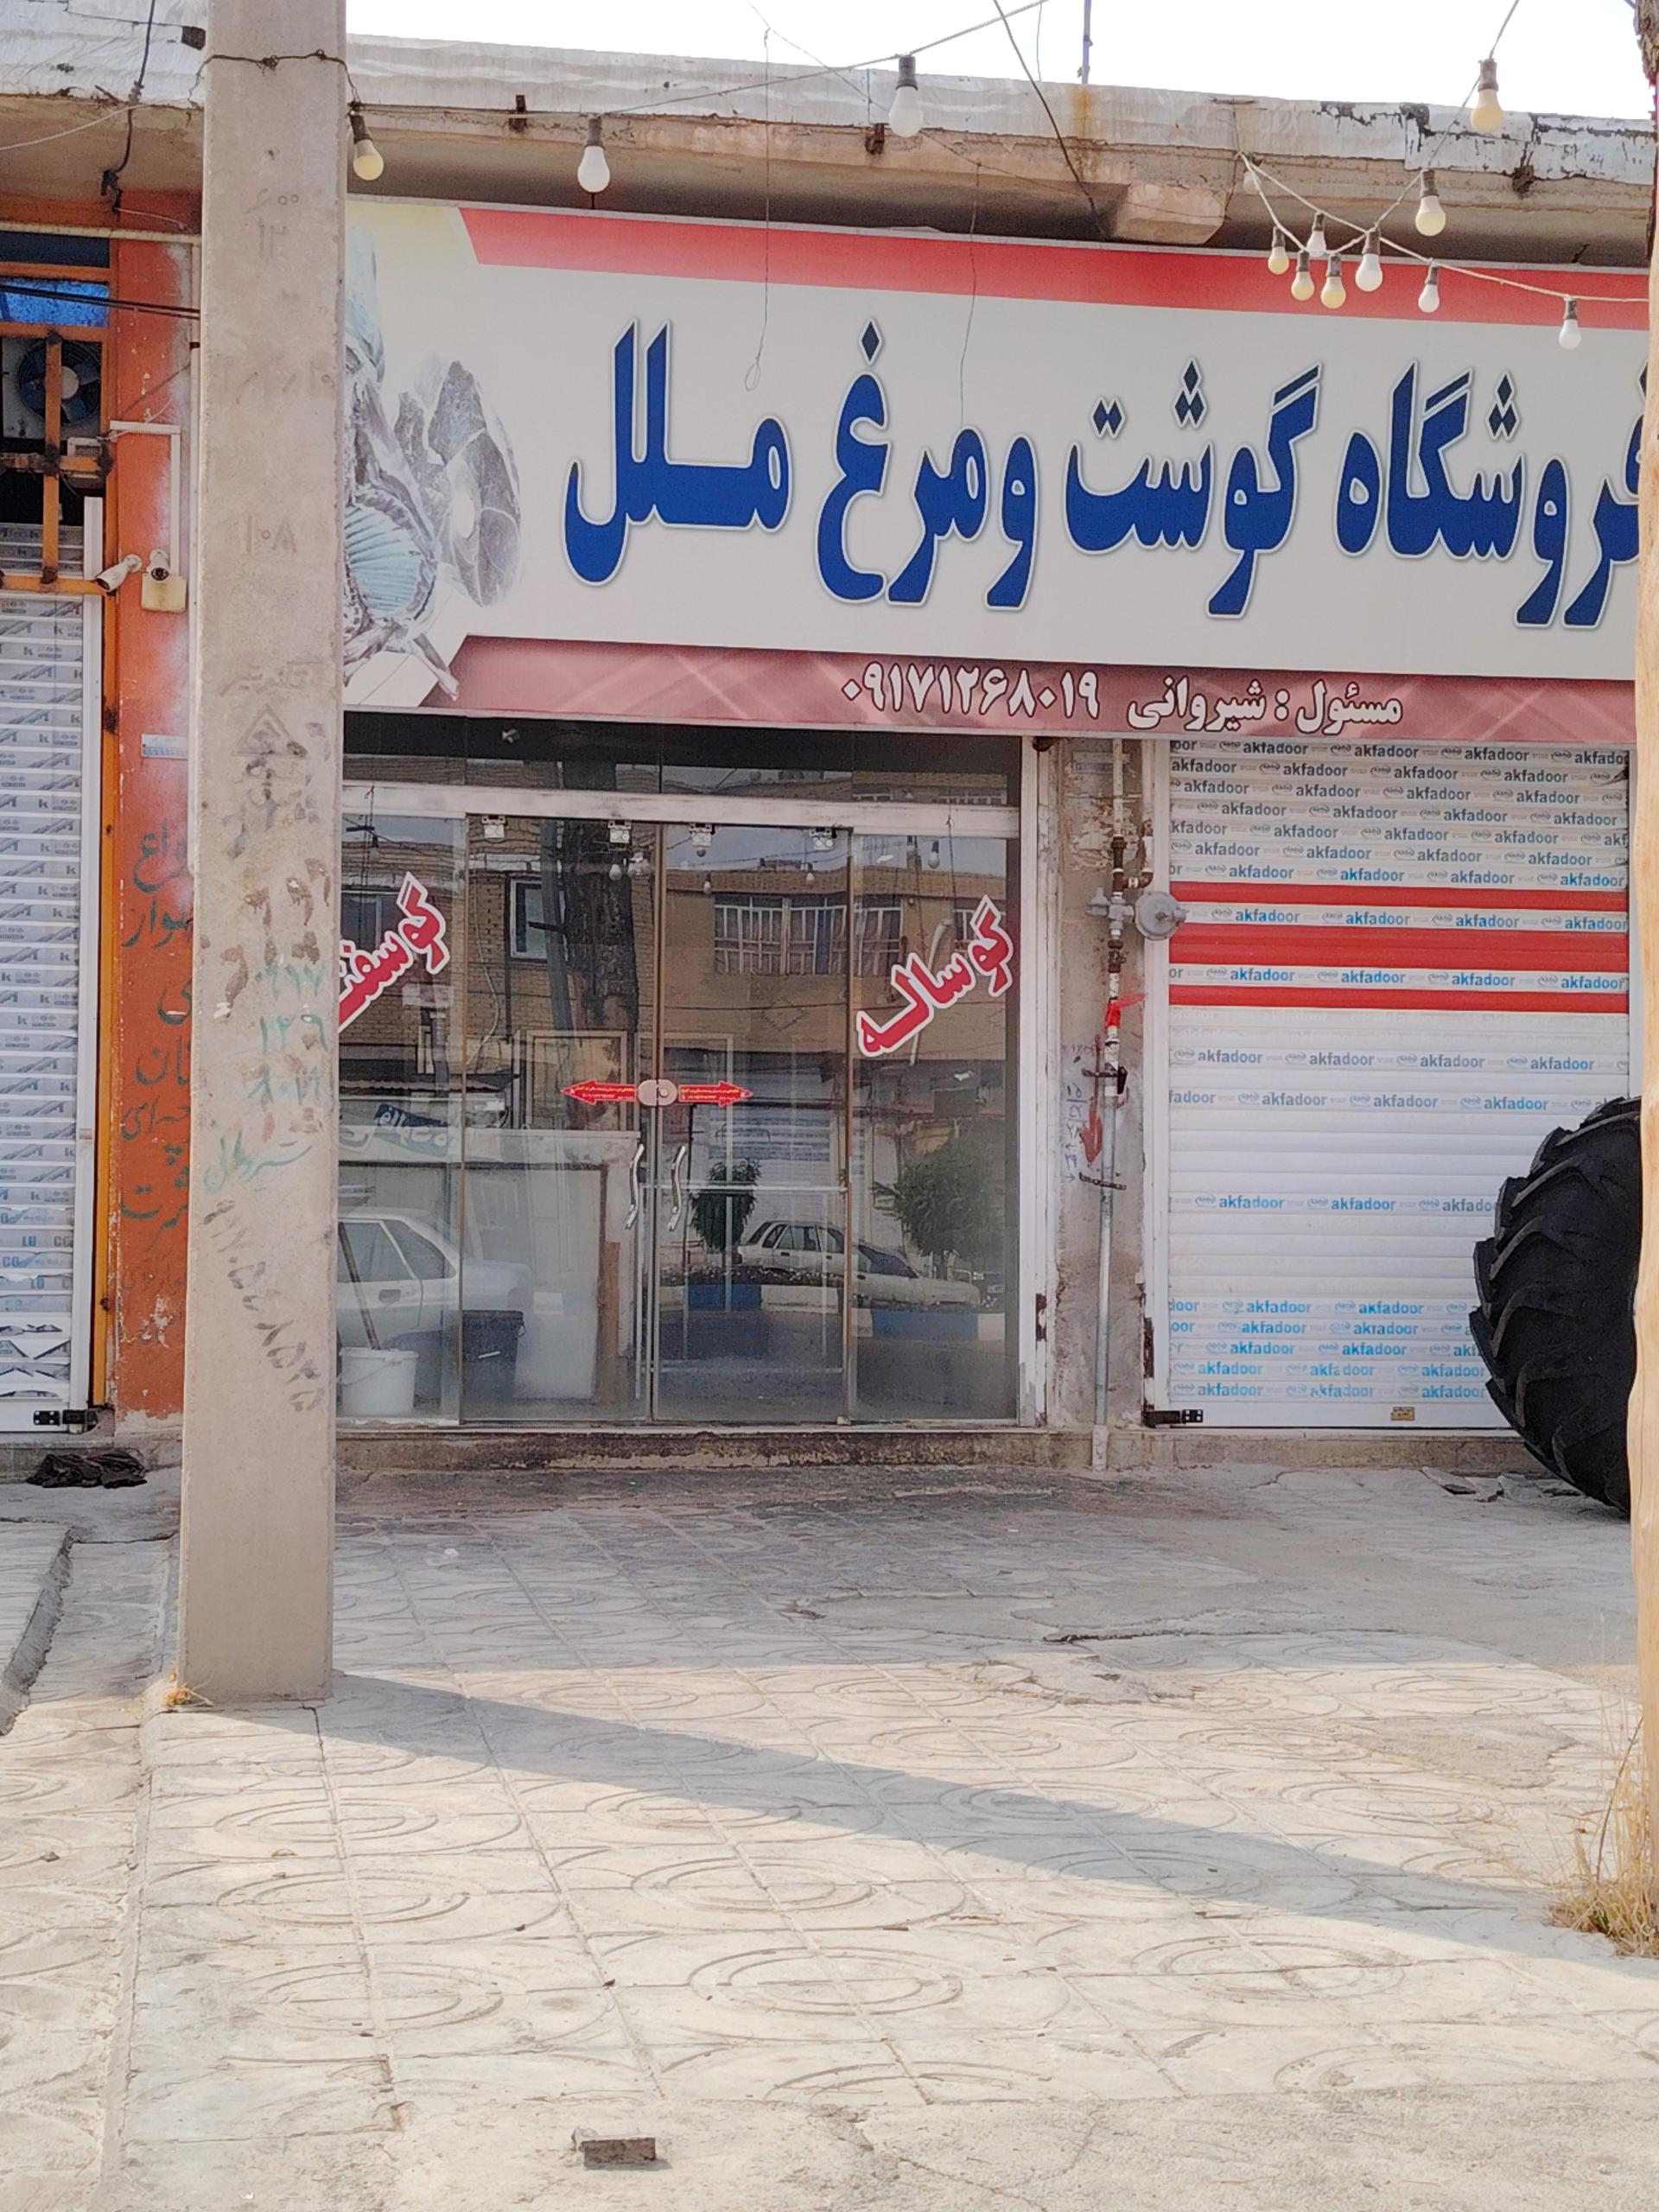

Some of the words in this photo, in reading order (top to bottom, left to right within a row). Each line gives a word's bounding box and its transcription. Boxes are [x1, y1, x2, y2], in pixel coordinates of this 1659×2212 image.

[563, 316, 793, 588] ملل
[1065, 357, 1325, 619] گوشت
[842, 661, 1100, 720] ۰۹۱۷۱۲۶۸۰۱۹
[1127, 675, 1266, 732] شیروانی
[1354, 745, 1419, 758] akfadoor
[1465, 747, 1529, 760] akfadoor
[1574, 752, 1628, 765] akfado
[1172, 759, 1236, 772] akfadoor
[1283, 763, 1348, 777] akfadoor
[1394, 766, 1459, 779] akfadoor
[1503, 769, 1568, 782] akfadoor
[1184, 780, 1249, 793] akfadoor
[1296, 784, 1361, 798] akfadoor
[1407, 787, 1471, 801] akfadoor
[1516, 791, 1580, 804] akfadoor
[1222, 802, 1287, 816] akfadoor
[1333, 805, 1398, 819] akfadoor
[1444, 809, 1508, 822] akfadoor
[1554, 812, 1618, 826] akfadoor
[1172, 821, 1228, 835] kfadoor
[1274, 824, 1338, 838] akfadoor
[1384, 827, 1449, 841] akfadoor
[1495, 830, 1559, 844] akfadoor
[1195, 842, 1260, 856] akfadoor
[1306, 846, 1371, 860] akfadoor
[1417, 849, 1482, 862] akfadoor
[1529, 852, 1592, 866] akfadoor
[1229, 865, 1294, 879] akfadoor
[1340, 868, 1405, 881] akfadoor
[1451, 870, 1515, 884] akfadoor
[1560, 873, 1624, 887] akfadoor
[1236, 909, 1300, 923] akfadoor
[1345, 912, 1410, 925] akfadoor
[1456, 913, 1520, 928] akfadoor
[1564, 916, 1628, 930] akfadoor
[856, 894, 1014, 1058] گوساله
[1230, 968, 1294, 982] akfadoor
[1341, 970, 1406, 983] akfadoor
[1452, 973, 1516, 987] akfadoor
[1560, 976, 1624, 989] akfadoor
[1198, 1049, 1262, 1064] akfadoor
[1309, 1052, 1374, 1065] akfadoor
[1420, 1054, 1484, 1068] akfadoor
[1530, 1056, 1595, 1071] akfadoor
[1262, 1091, 1327, 1106] akfadoor
[1373, 1094, 1438, 1108] akfadoor
[1484, 1096, 1548, 1110] akfadoor
[1218, 1195, 1285, 1209] akfadoor
[1332, 1197, 1396, 1211] akfadoor
[1442, 1198, 1496, 1212] akfado
[1246, 1300, 1312, 1313] akfadoor
[1241, 1320, 1307, 1334] akfadoor
[1230, 1341, 1295, 1355] akfadoor
[1342, 1342, 1408, 1356] akfadoor
[1198, 1361, 1263, 1375] akfadoor
[1198, 1382, 1263, 1397] akfadoor
